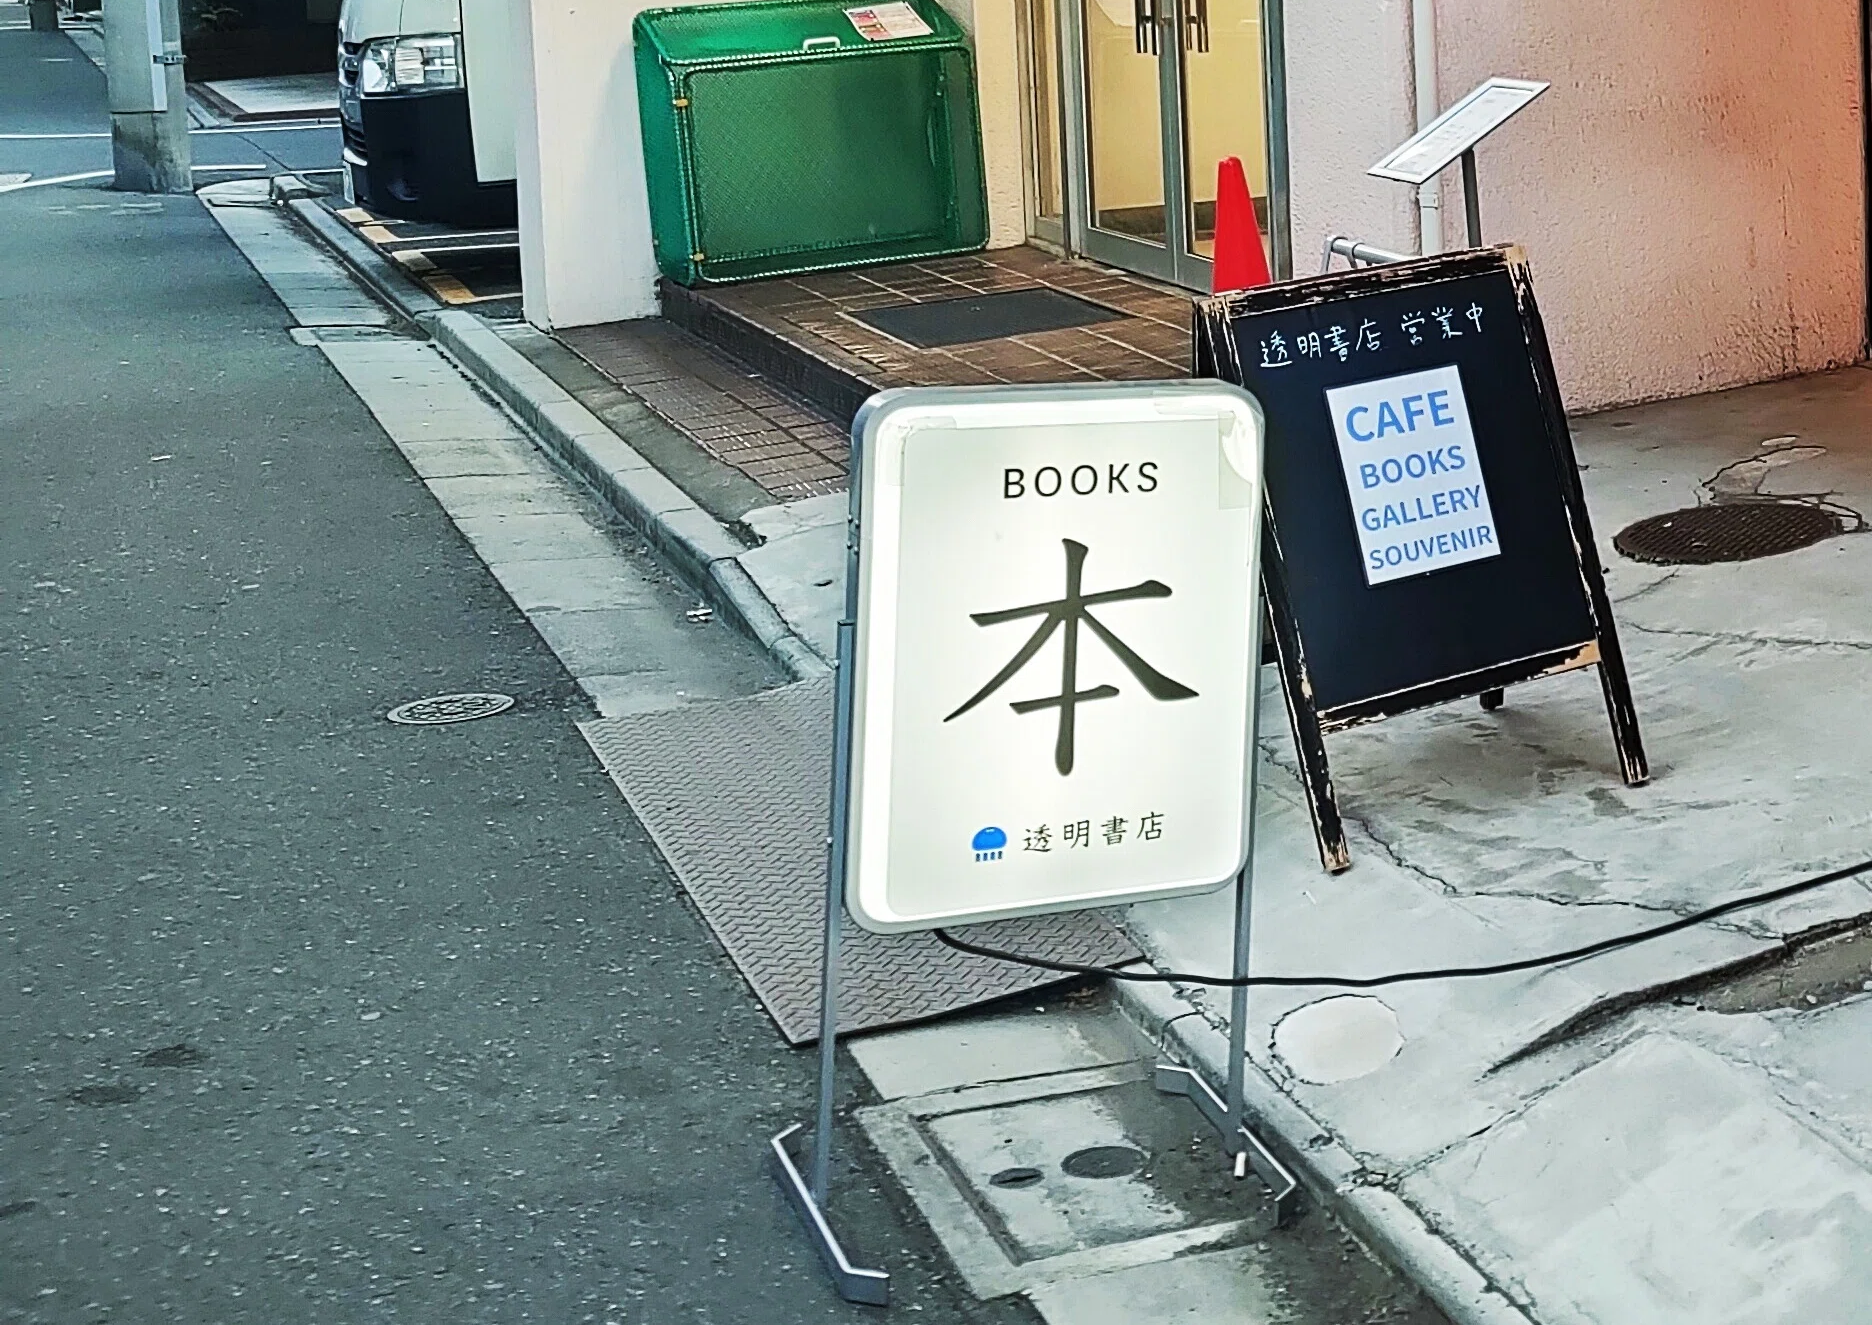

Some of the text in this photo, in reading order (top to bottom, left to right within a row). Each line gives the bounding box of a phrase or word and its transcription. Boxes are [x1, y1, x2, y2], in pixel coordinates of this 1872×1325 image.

[1259, 302, 1485, 369] 透明書店 営業中
[1345, 389, 1456, 443] CAFE
[1002, 461, 1160, 499] BOOKS
[1359, 444, 1467, 490] BOOKS
[1361, 484, 1481, 532] GALLERY
[1369, 524, 1493, 571] SOUVENIR
[942, 537, 1200, 777] 本
[1022, 811, 1165, 854] 透明書店
